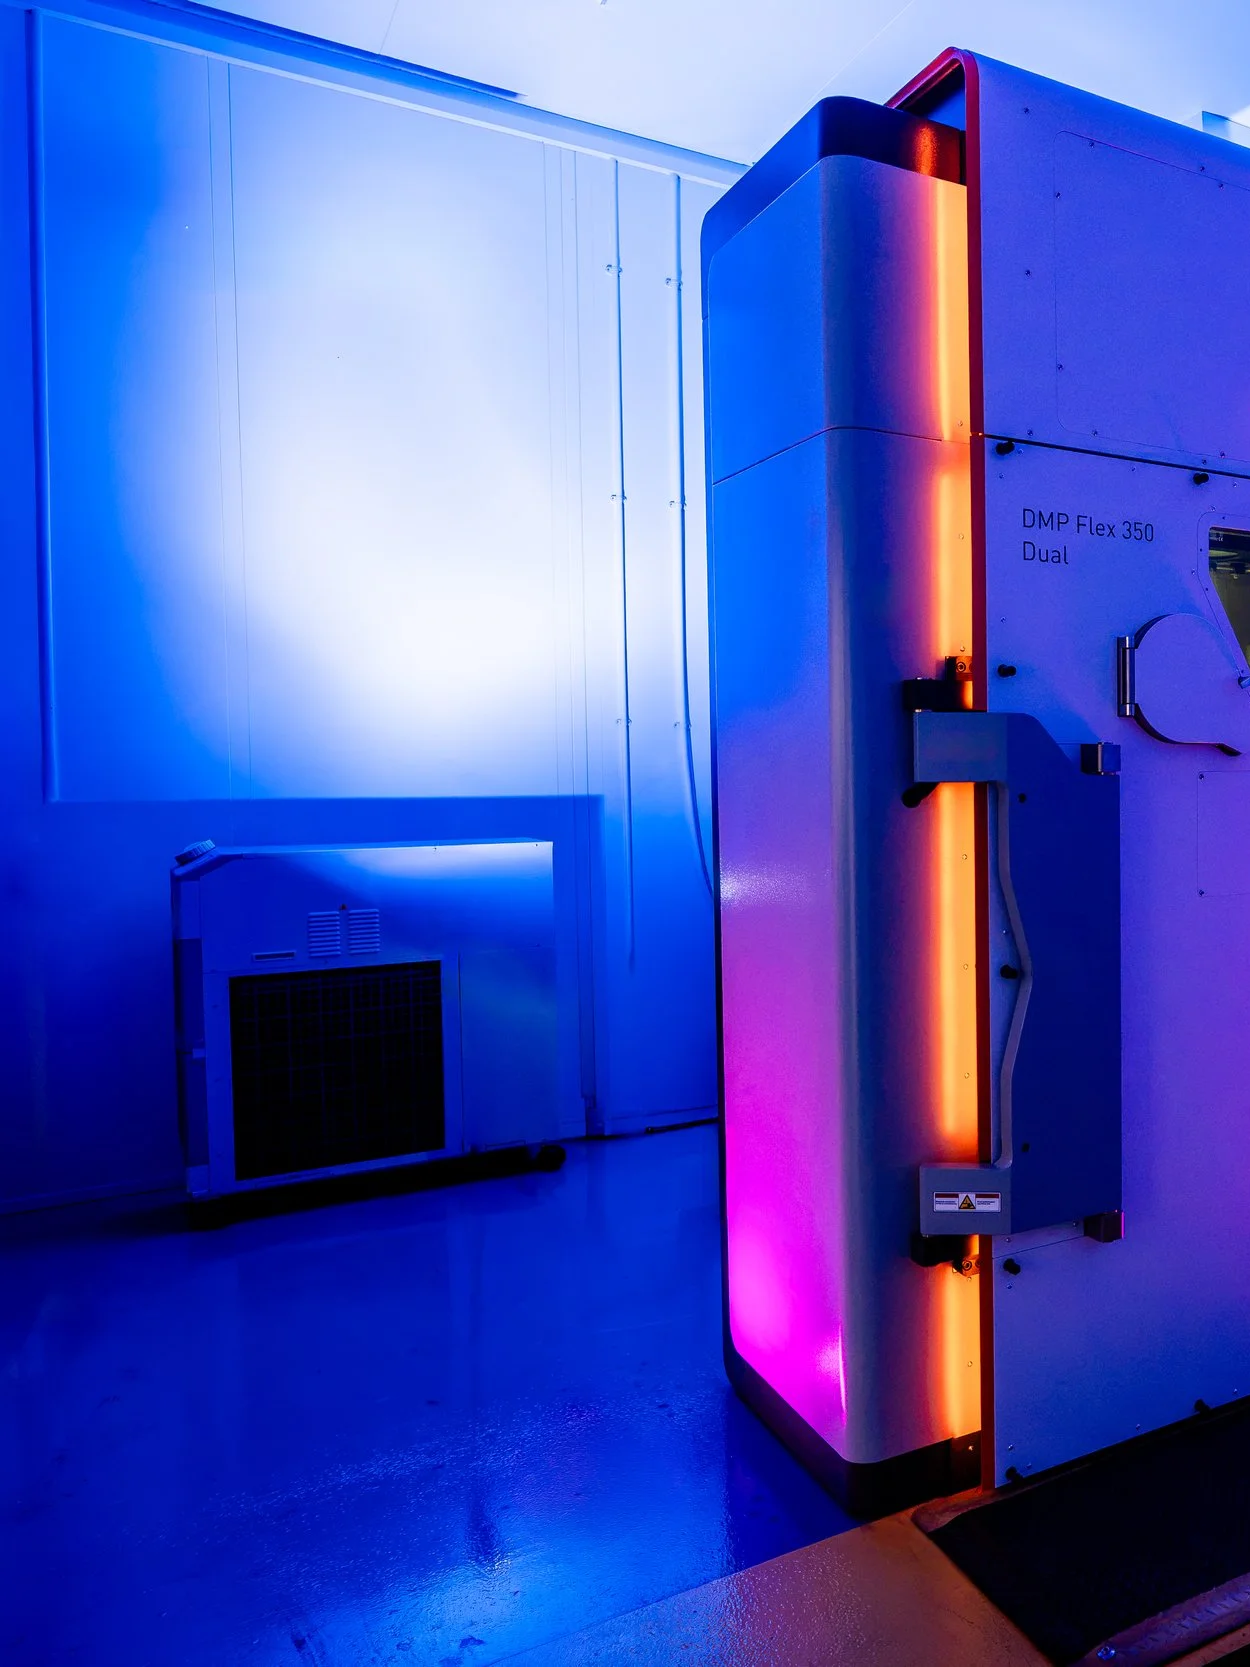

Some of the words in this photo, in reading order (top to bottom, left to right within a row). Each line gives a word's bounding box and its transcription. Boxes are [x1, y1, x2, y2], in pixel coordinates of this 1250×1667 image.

[1022, 508, 1069, 531] DMP
[1076, 515, 1116, 538] Flex
[1122, 521, 1154, 542] 350
[1022, 541, 1069, 565] Dual
